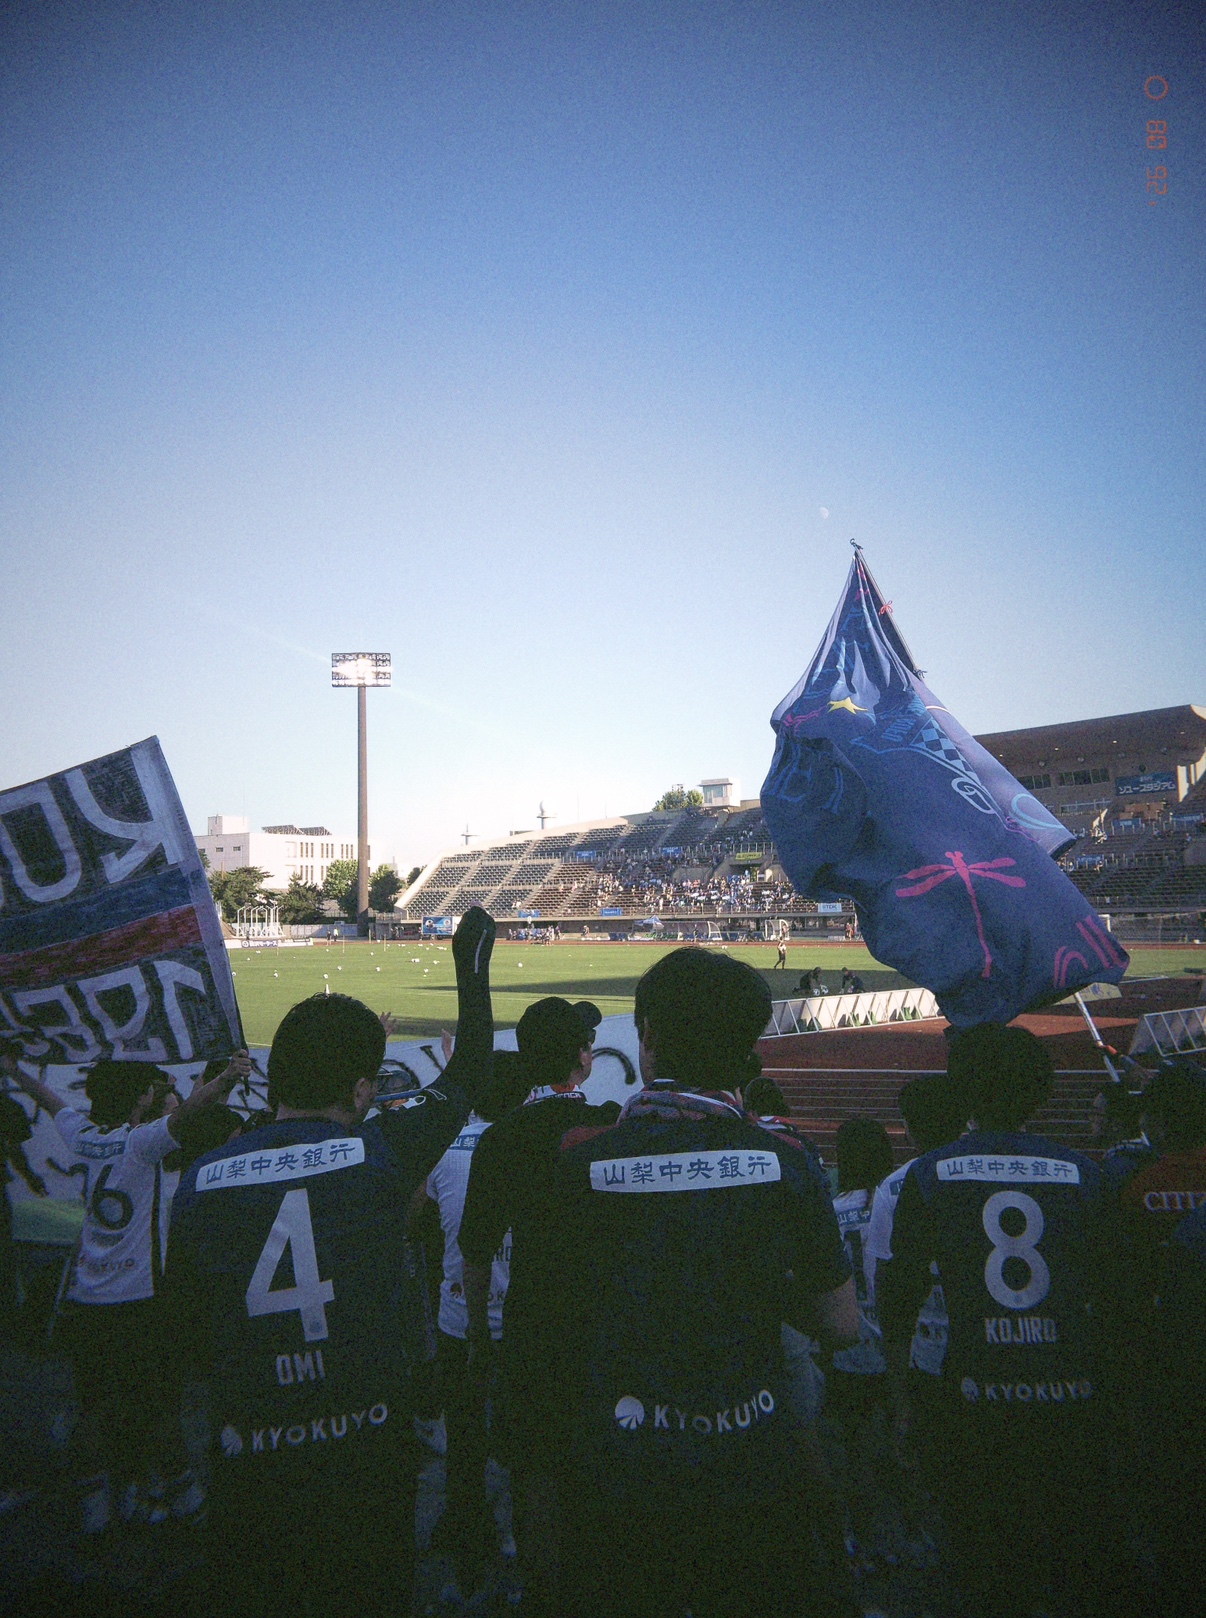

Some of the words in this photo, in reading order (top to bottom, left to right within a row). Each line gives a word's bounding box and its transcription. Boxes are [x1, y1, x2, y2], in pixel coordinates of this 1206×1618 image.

[206, 1143, 356, 1185] 山梨中央銀行
[603, 1155, 772, 1186] 山梨中央銀行
[947, 1158, 1073, 1178] 山梨中央銀行
[246, 1188, 335, 1342] 4
[982, 1190, 1051, 1310] 8
[984, 1316, 1058, 1344] KOJIRO
[276, 1350, 326, 1386] OMI
[984, 1378, 1094, 1404] KYOKUYO
[251, 1402, 389, 1454] KYOKUYO
[653, 1388, 776, 1435] KYOKUYO
